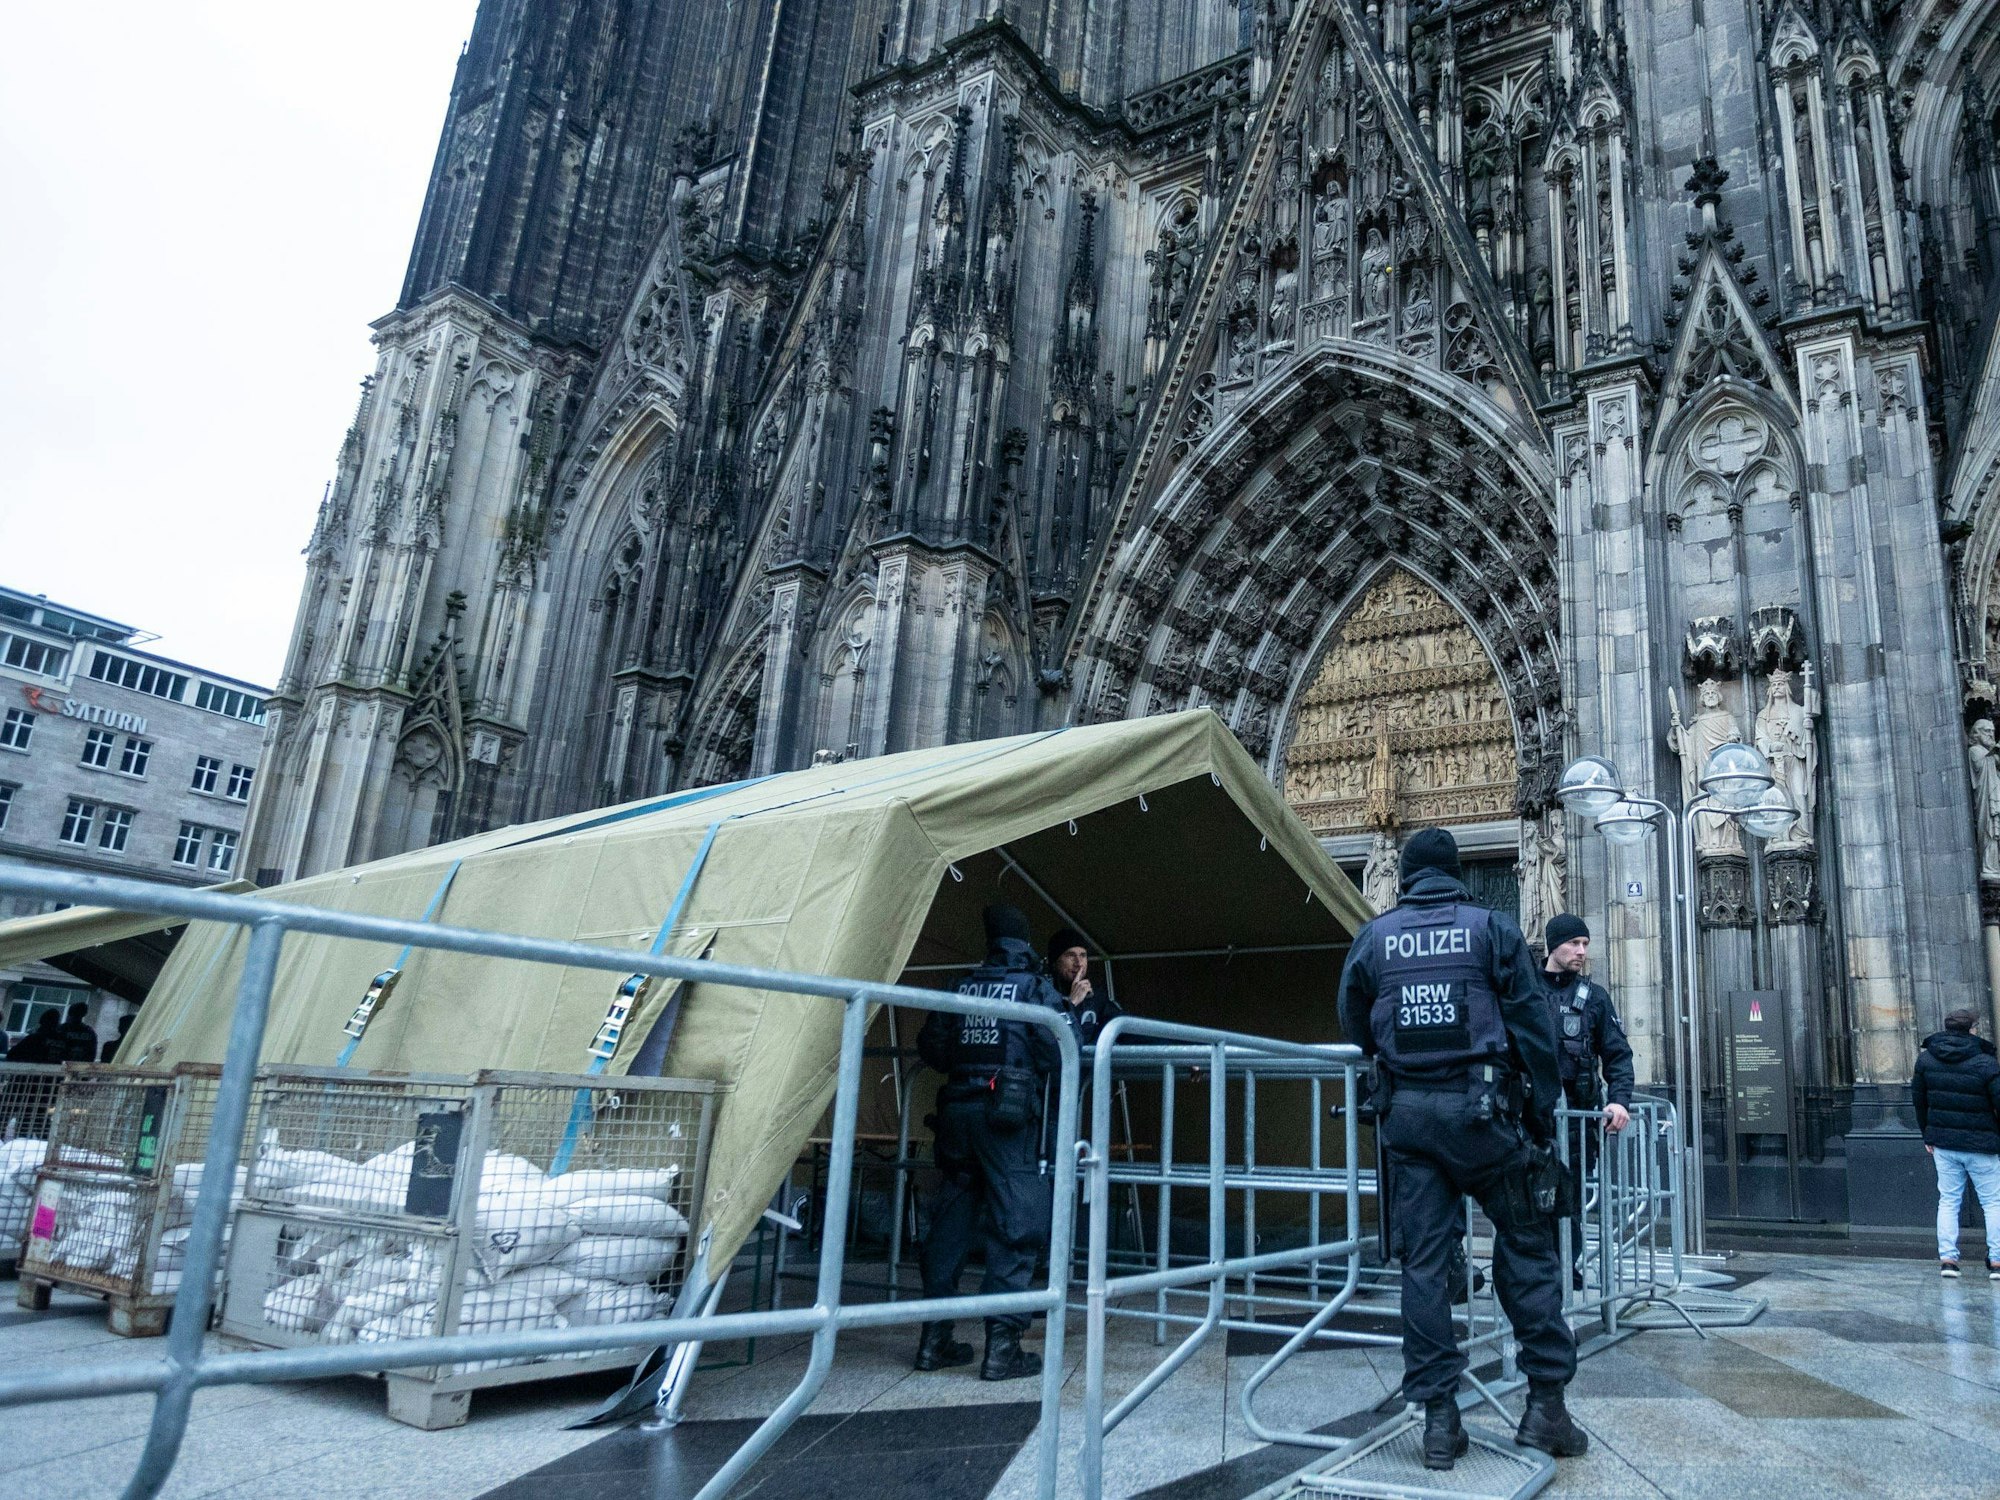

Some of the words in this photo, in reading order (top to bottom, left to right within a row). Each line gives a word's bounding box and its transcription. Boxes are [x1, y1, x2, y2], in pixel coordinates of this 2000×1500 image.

[62, 698, 148, 735] SATURN
[1385, 928, 1471, 960] POLIZEI
[959, 984, 1018, 1002] POLIZEI
[1402, 984, 1451, 1004] NRW
[964, 1014, 998, 1028] NRW
[1400, 1004, 1456, 1026] 31533
[961, 1029, 999, 1045] 31532
